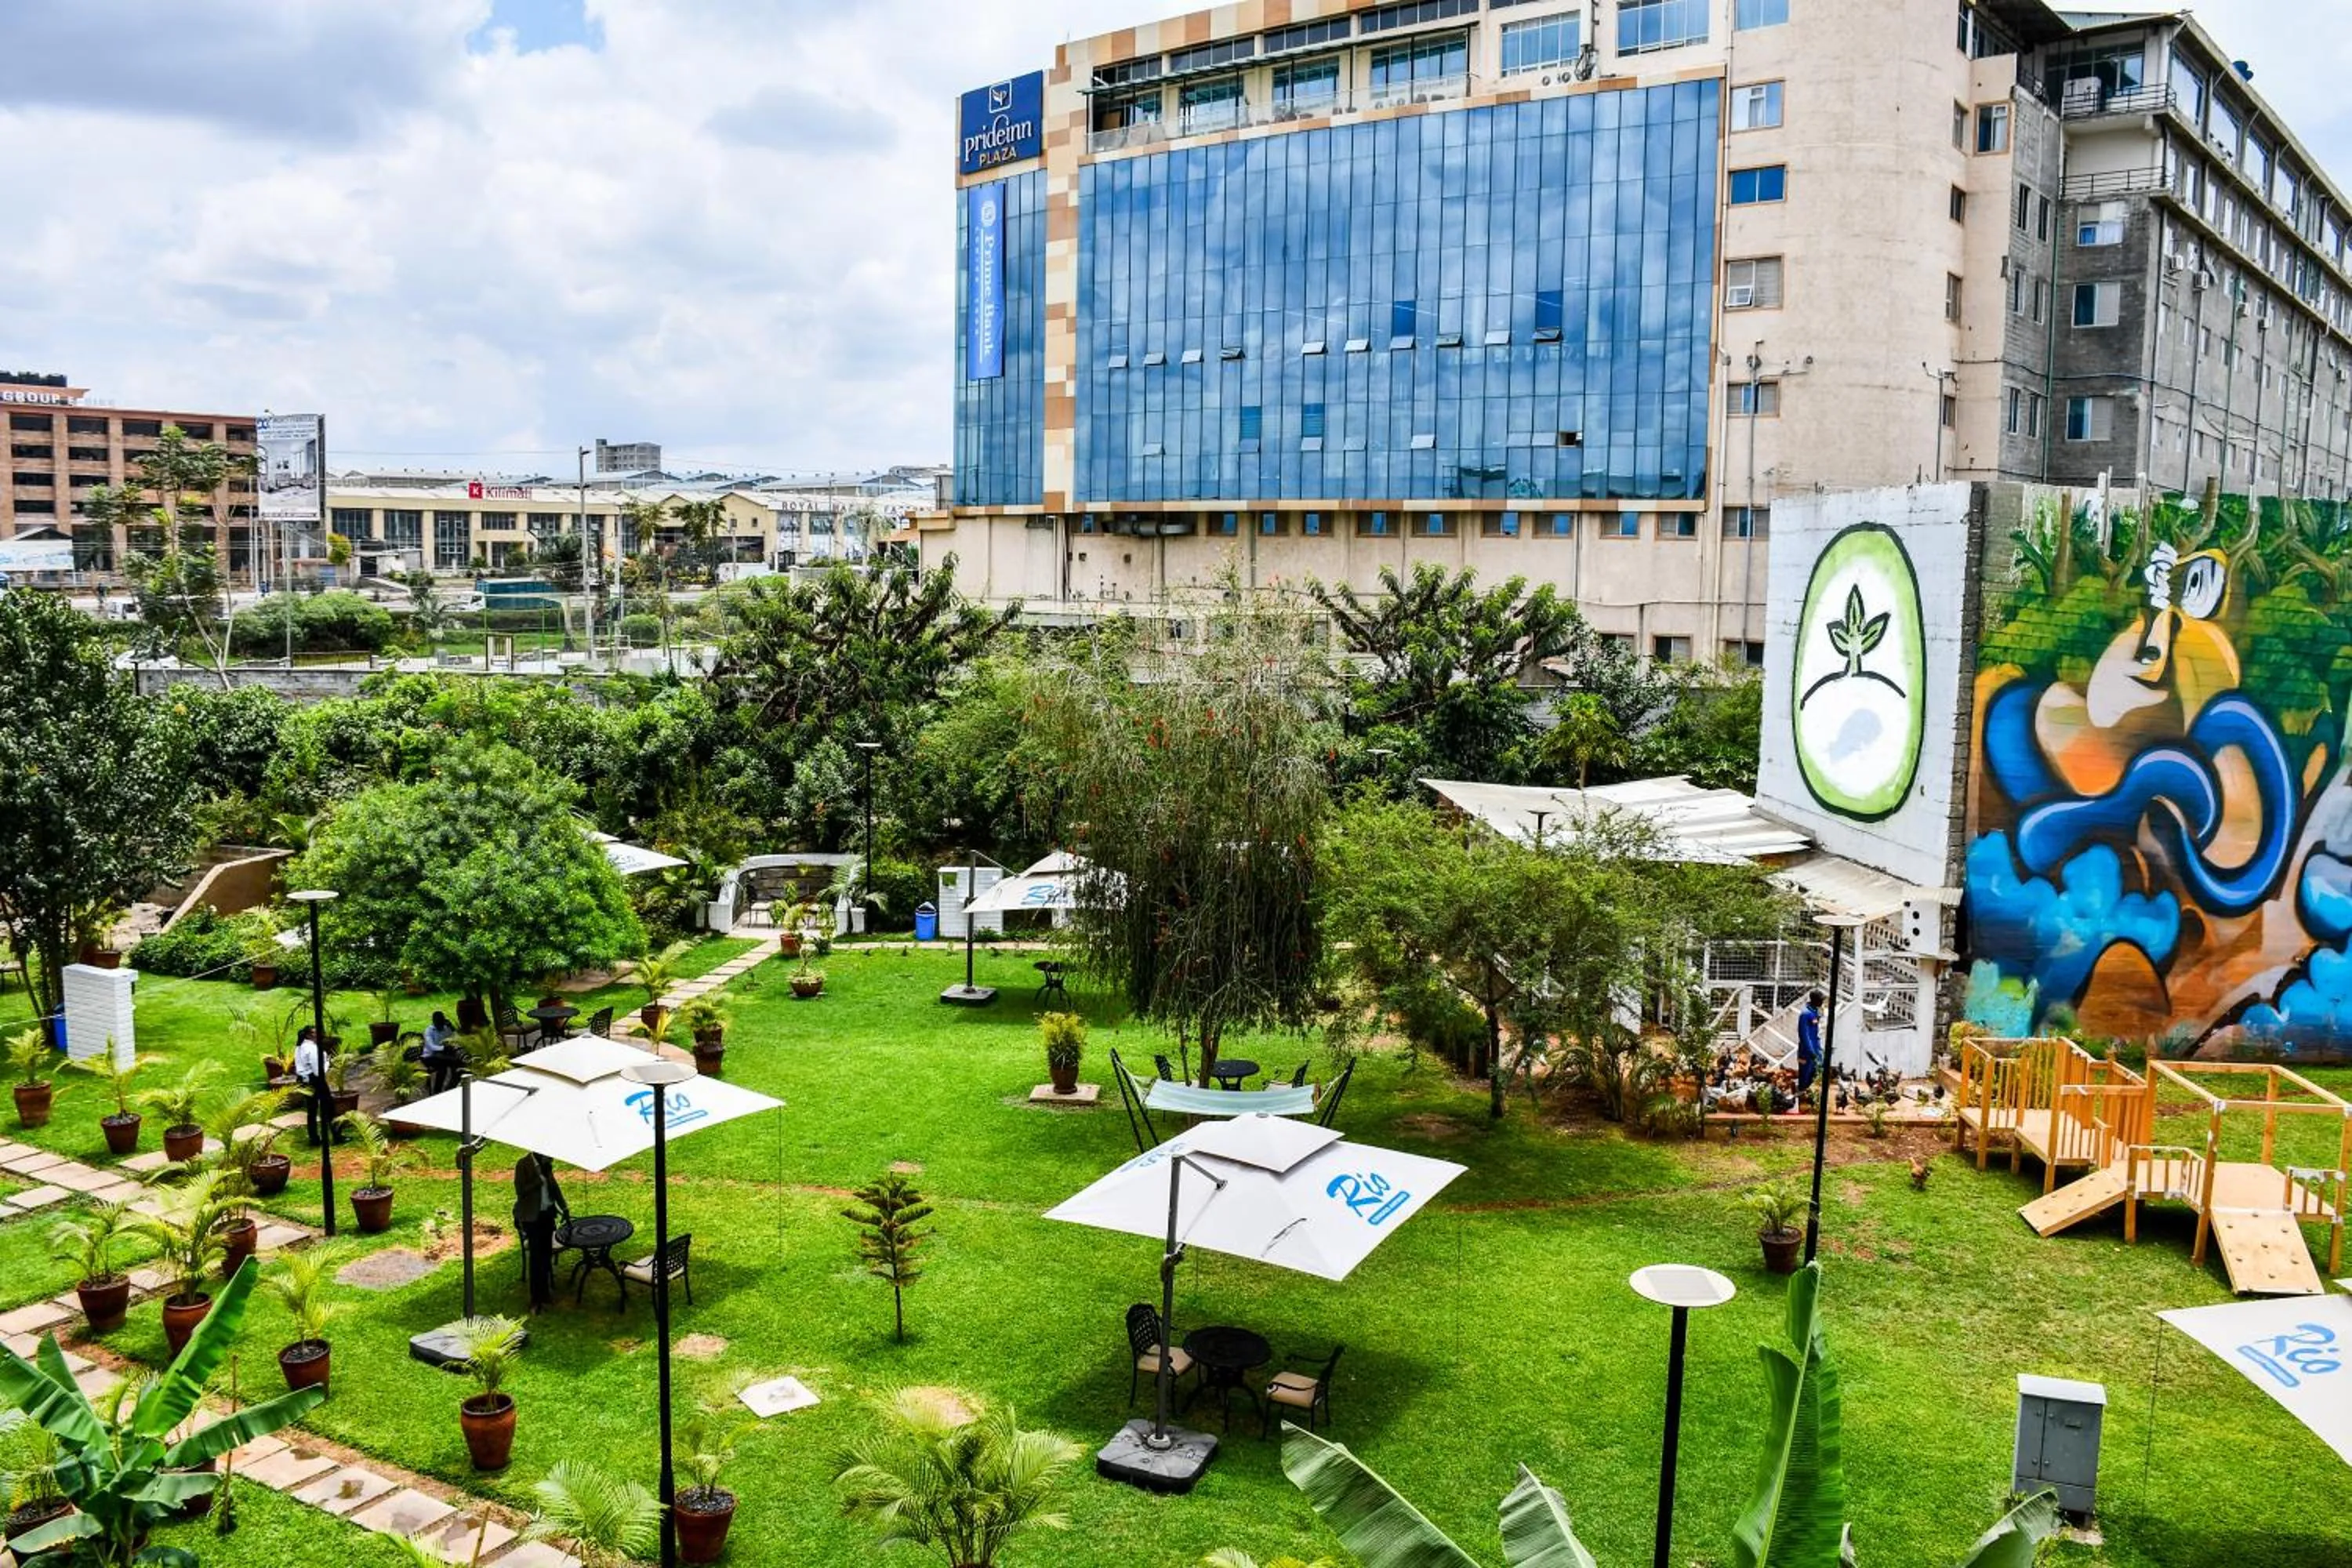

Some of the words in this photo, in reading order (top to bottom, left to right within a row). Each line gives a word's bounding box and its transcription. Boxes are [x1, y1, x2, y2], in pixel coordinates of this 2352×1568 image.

[964, 114, 1032, 162] prideinn
[979, 147, 1017, 166] PLAZA
[983, 235, 995, 298] Prime
[983, 303, 995, 356] Bank
[2, 391, 60, 404] GROUP
[1327, 1171, 1391, 1217] Rio
[2253, 1323, 2342, 1374] Rio
